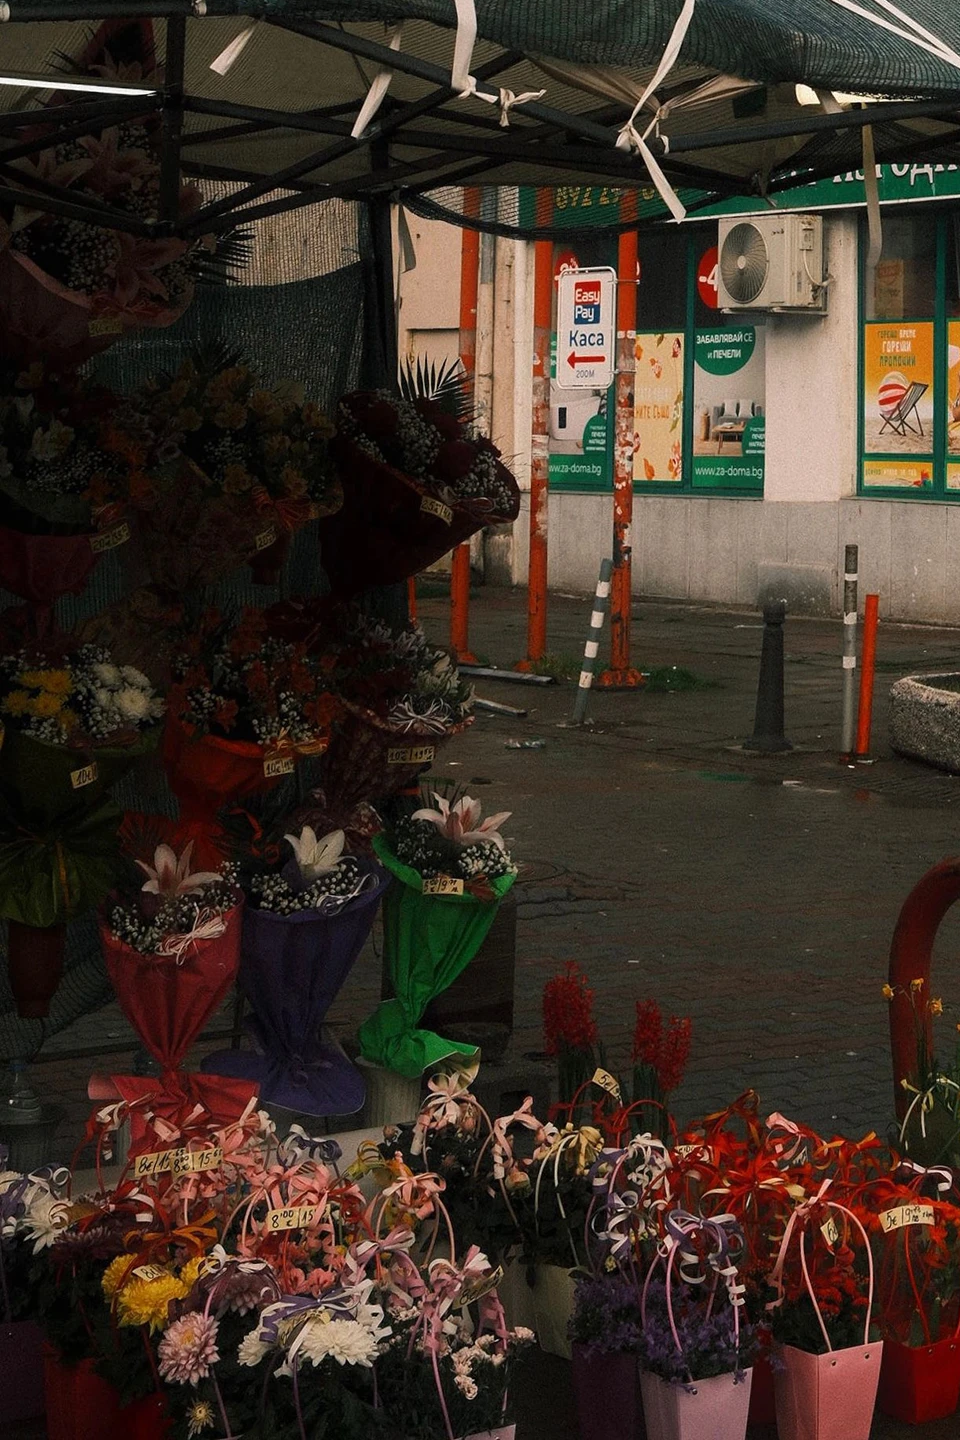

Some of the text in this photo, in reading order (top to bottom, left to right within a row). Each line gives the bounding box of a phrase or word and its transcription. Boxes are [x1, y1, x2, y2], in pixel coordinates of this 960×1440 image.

[575, 289, 600, 305] Easy
[575, 305, 595, 322] Pay
[569, 330, 604, 347] Каса
[696, 332, 753, 344] ЗАБАВЛЯВАЙ СЕ
[713, 349, 741, 359] ПЕЧЕЛИ
[695, 465, 763, 480] www.za-doma.bg
